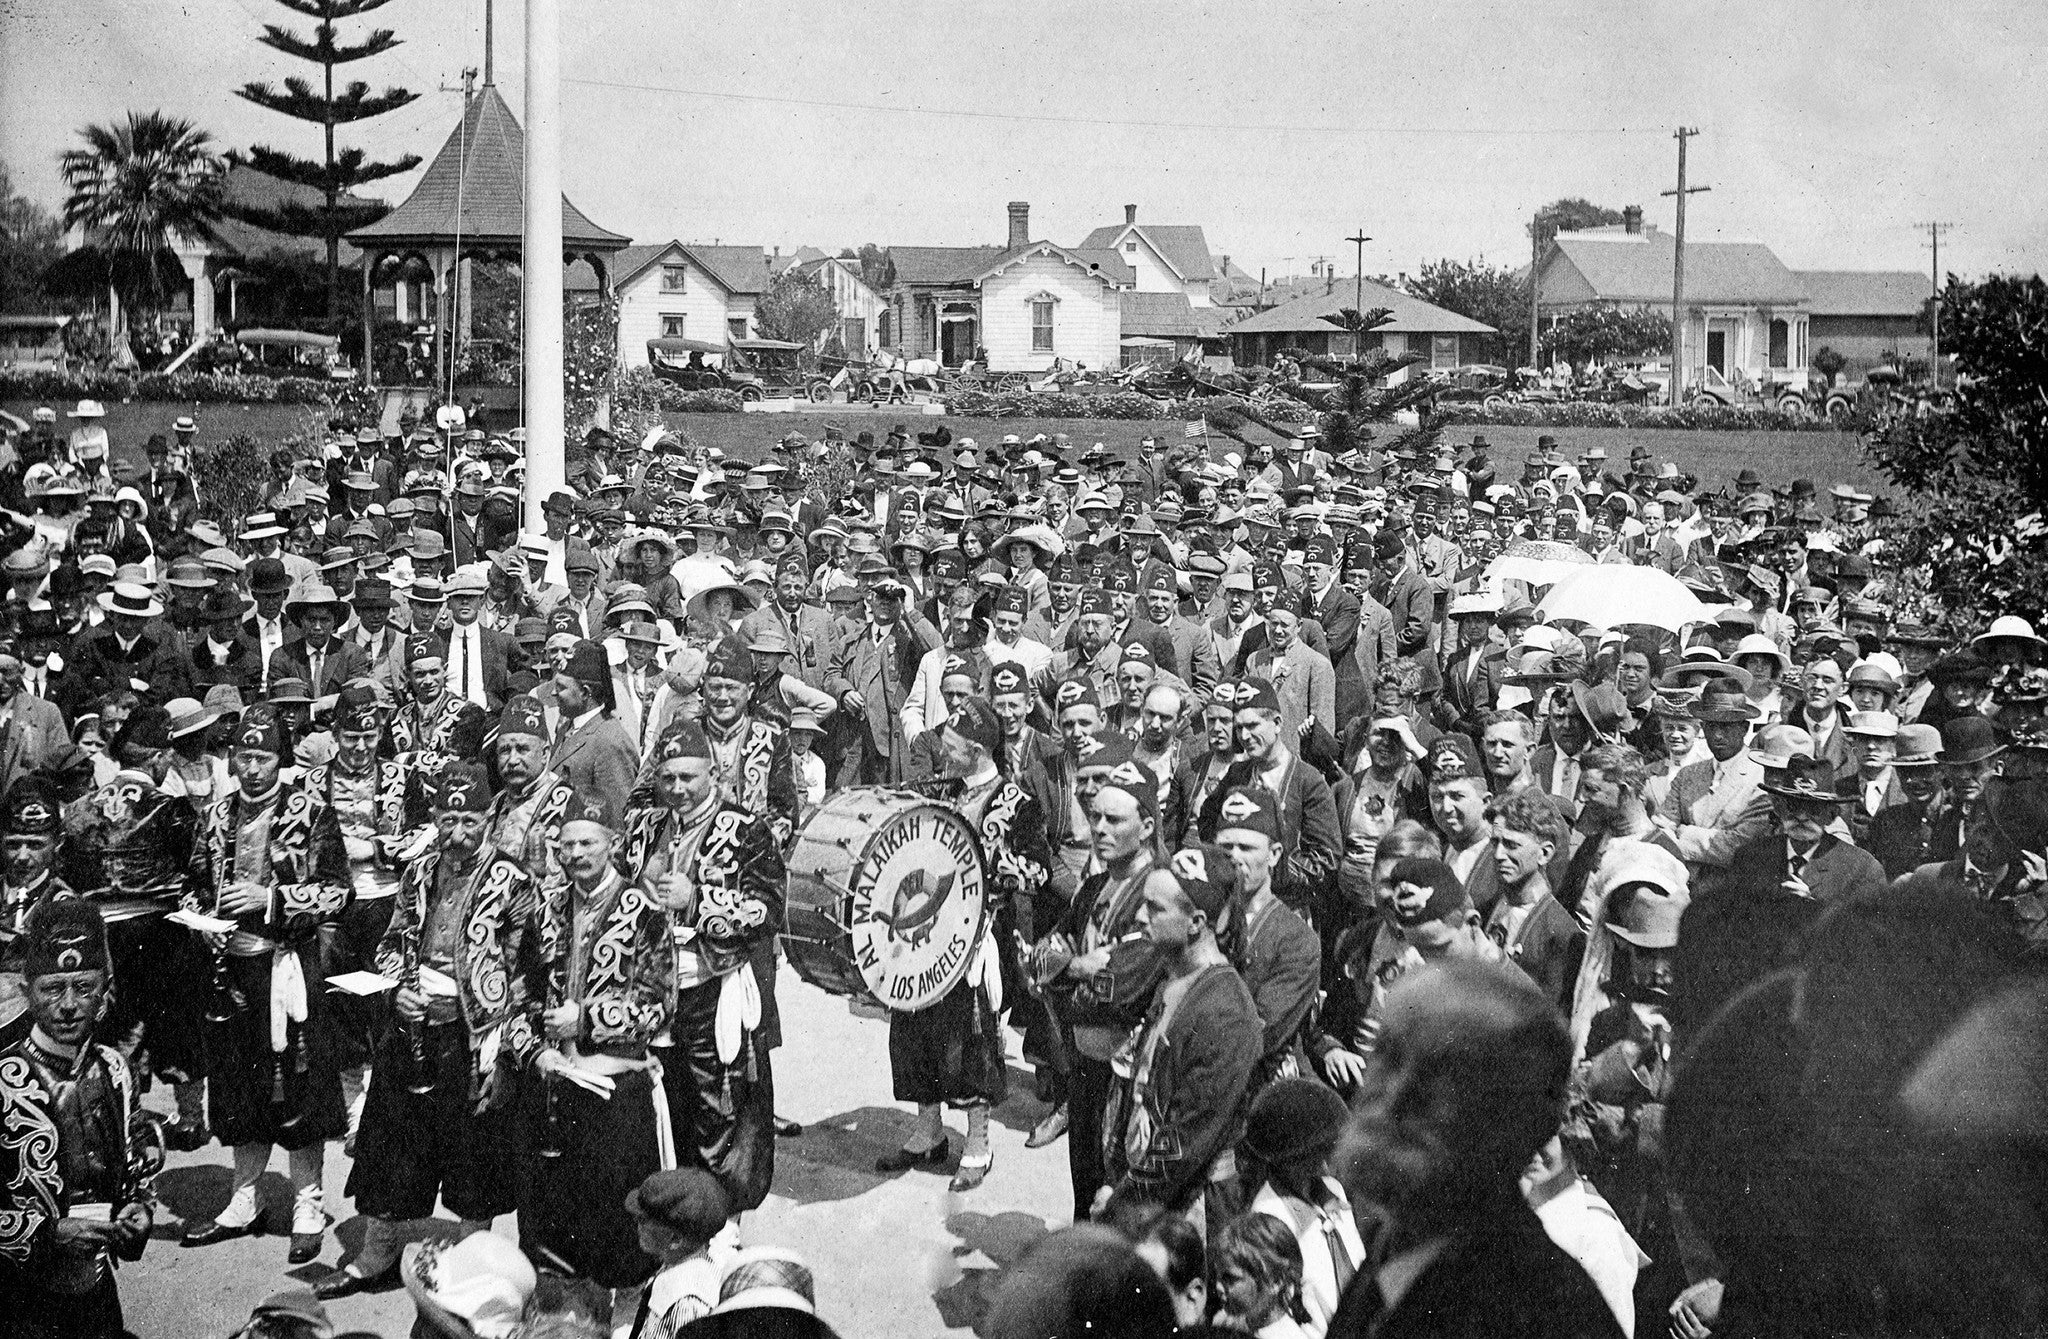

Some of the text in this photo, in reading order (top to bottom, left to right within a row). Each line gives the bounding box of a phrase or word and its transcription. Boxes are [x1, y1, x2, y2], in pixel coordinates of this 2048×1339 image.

[854, 814, 979, 971] AL MALAIKAH TEMPLE
[890, 933, 966, 1000] LOS ANGELES
